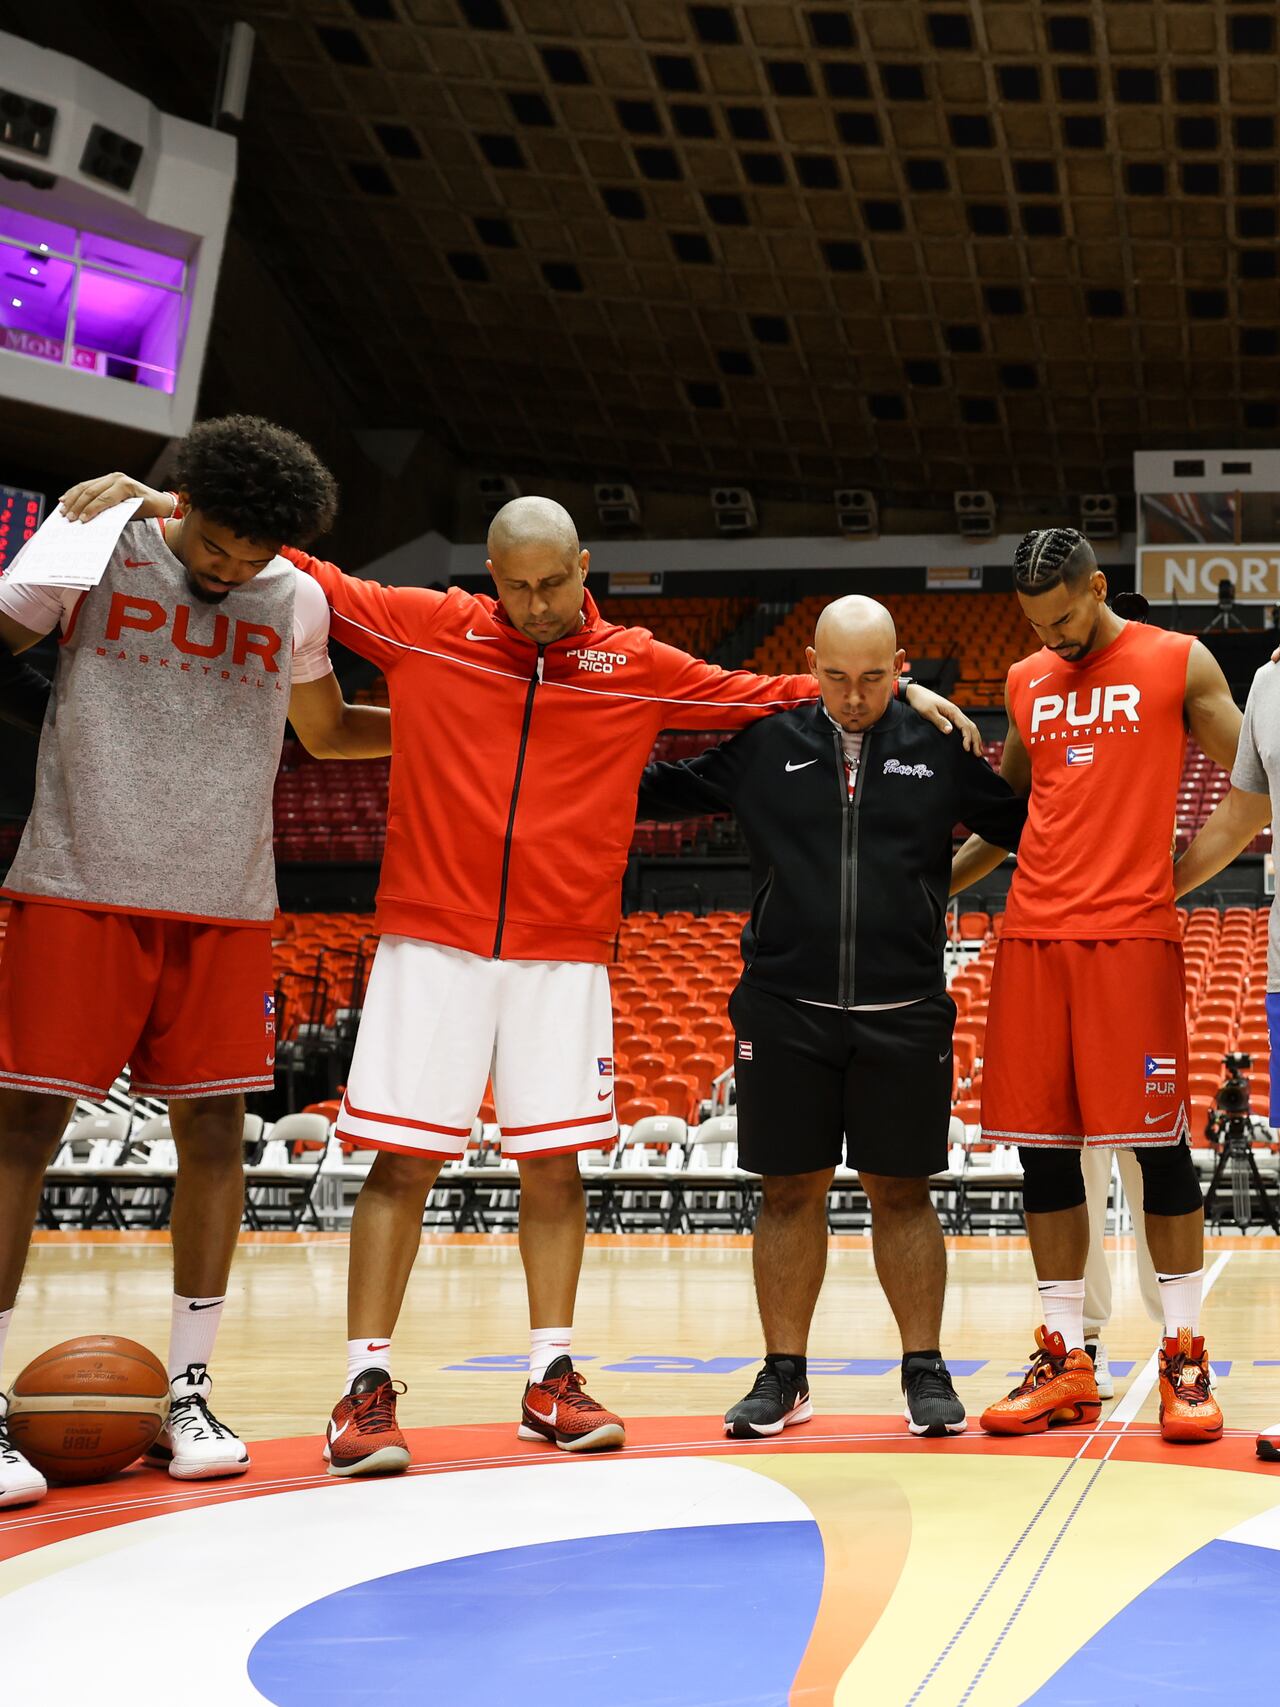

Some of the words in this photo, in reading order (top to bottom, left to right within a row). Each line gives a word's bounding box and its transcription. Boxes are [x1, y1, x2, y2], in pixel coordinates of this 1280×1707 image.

[4, 327, 93, 370] Mobe
[105, 591, 282, 673] PUR
[96, 647, 282, 690] BASKETBALL
[566, 649, 627, 665] PUERTO
[578, 659, 614, 674] RICO
[1031, 684, 1141, 734] PUR
[1030, 725, 1140, 745] BASKETBALL
[1145, 1082, 1176, 1095] PUR
